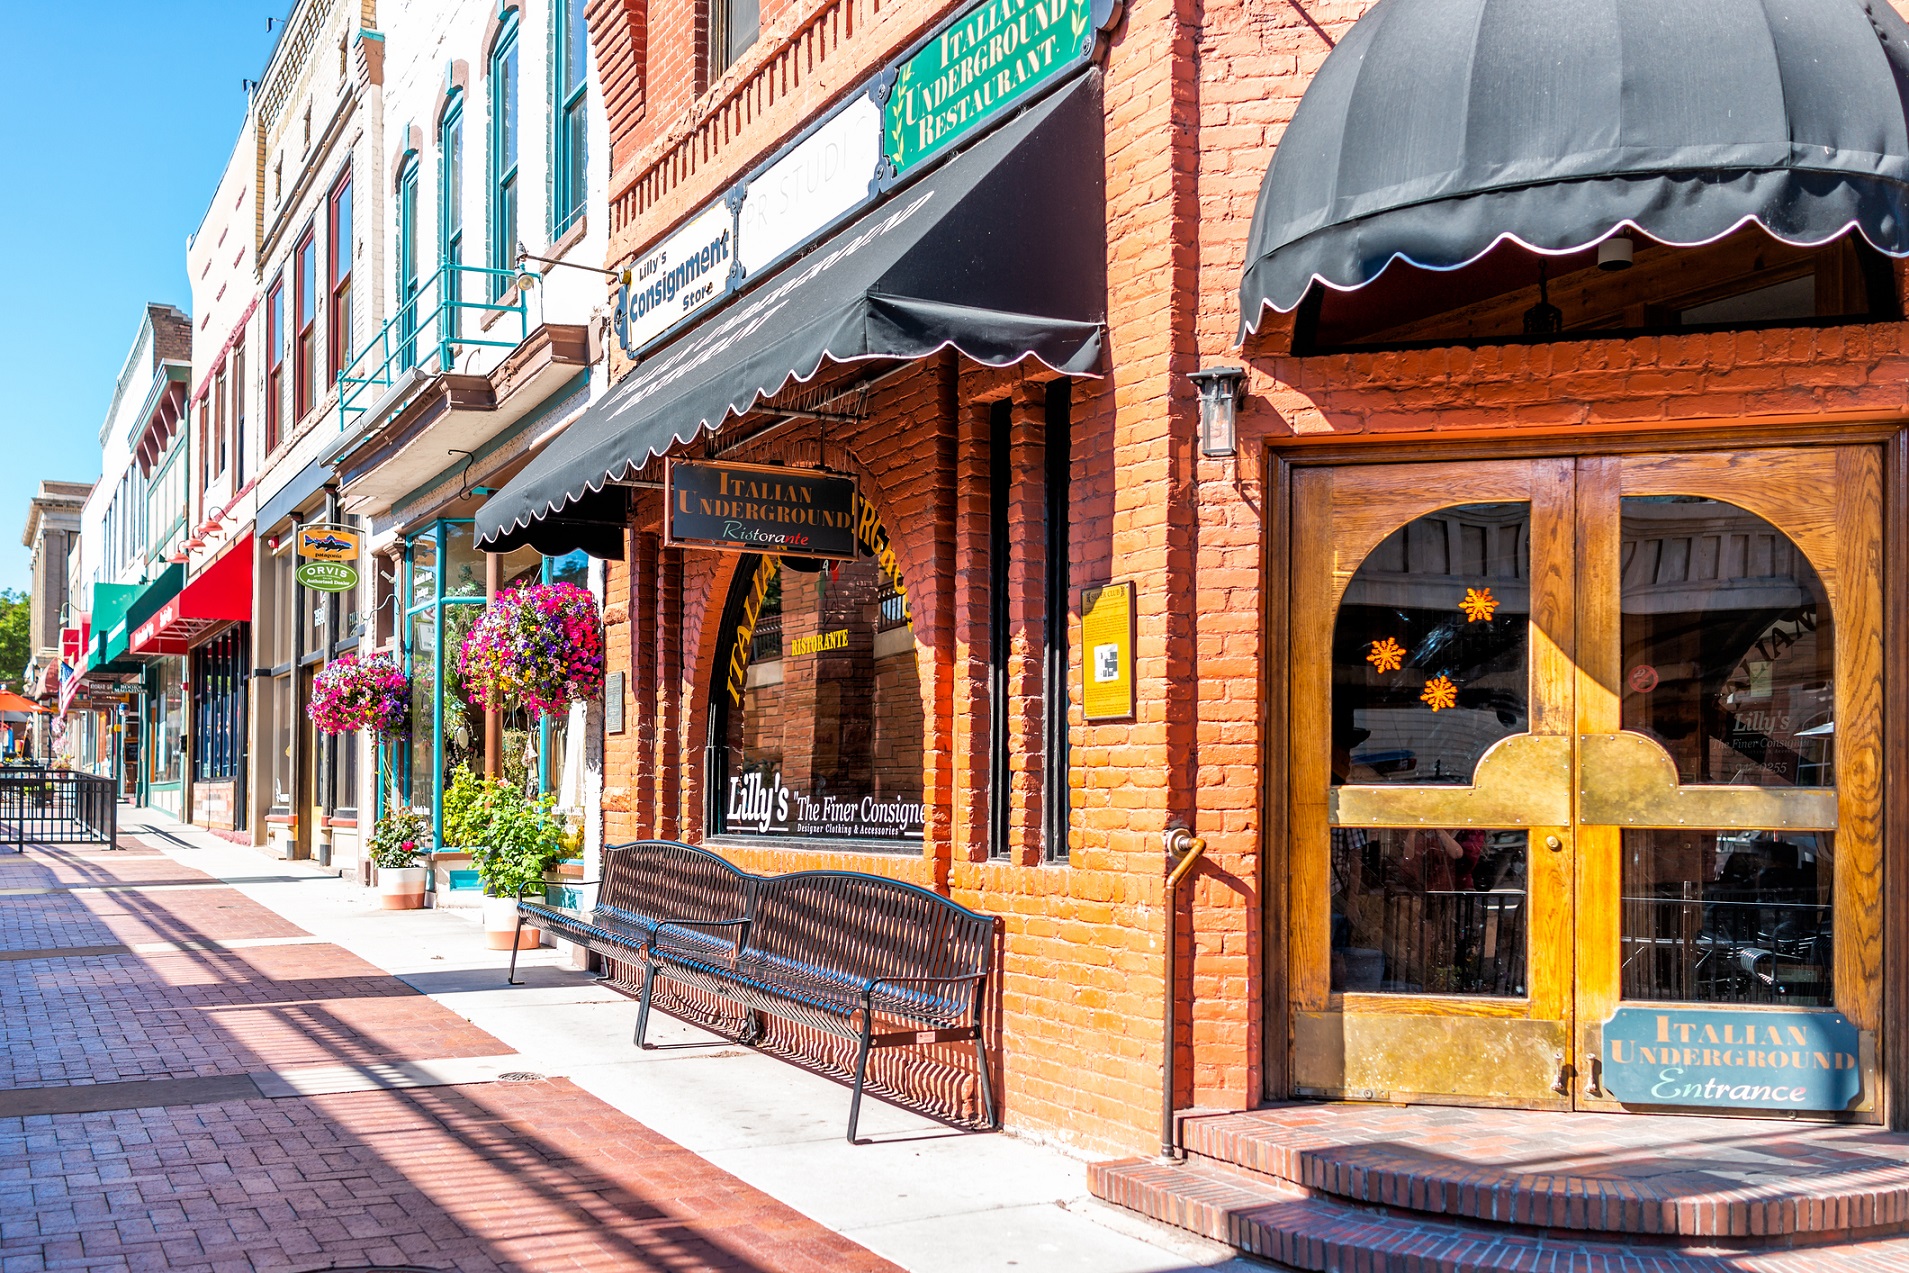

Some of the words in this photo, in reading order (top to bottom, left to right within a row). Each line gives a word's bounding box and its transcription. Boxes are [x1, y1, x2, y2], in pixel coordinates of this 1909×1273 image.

[905, 0, 1068, 126] UNDERGROUND
[918, 35, 1057, 152] RESTAURANT
[639, 251, 667, 282] Lilly's
[719, 471, 812, 504] ITALIAN
[678, 489, 850, 529] UNDERGROUND
[722, 519, 809, 546] Ristorante
[306, 566, 348, 578] ORVIS
[791, 629, 849, 657] RISTORANTE
[1732, 710, 1791, 736] Lilly's
[727, 772, 789, 833] Lilly's
[822, 796, 858, 822] Finer
[797, 823, 823, 834] Designer
[825, 824, 852, 836] Clothing
[853, 825, 859, 834] &
[860, 825, 899, 836] Accessories
[1655, 1014, 1808, 1047] ITALIAN
[1610, 1039, 1855, 1071] UNDERGROUND
[1650, 1067, 1807, 1102] Entrance
